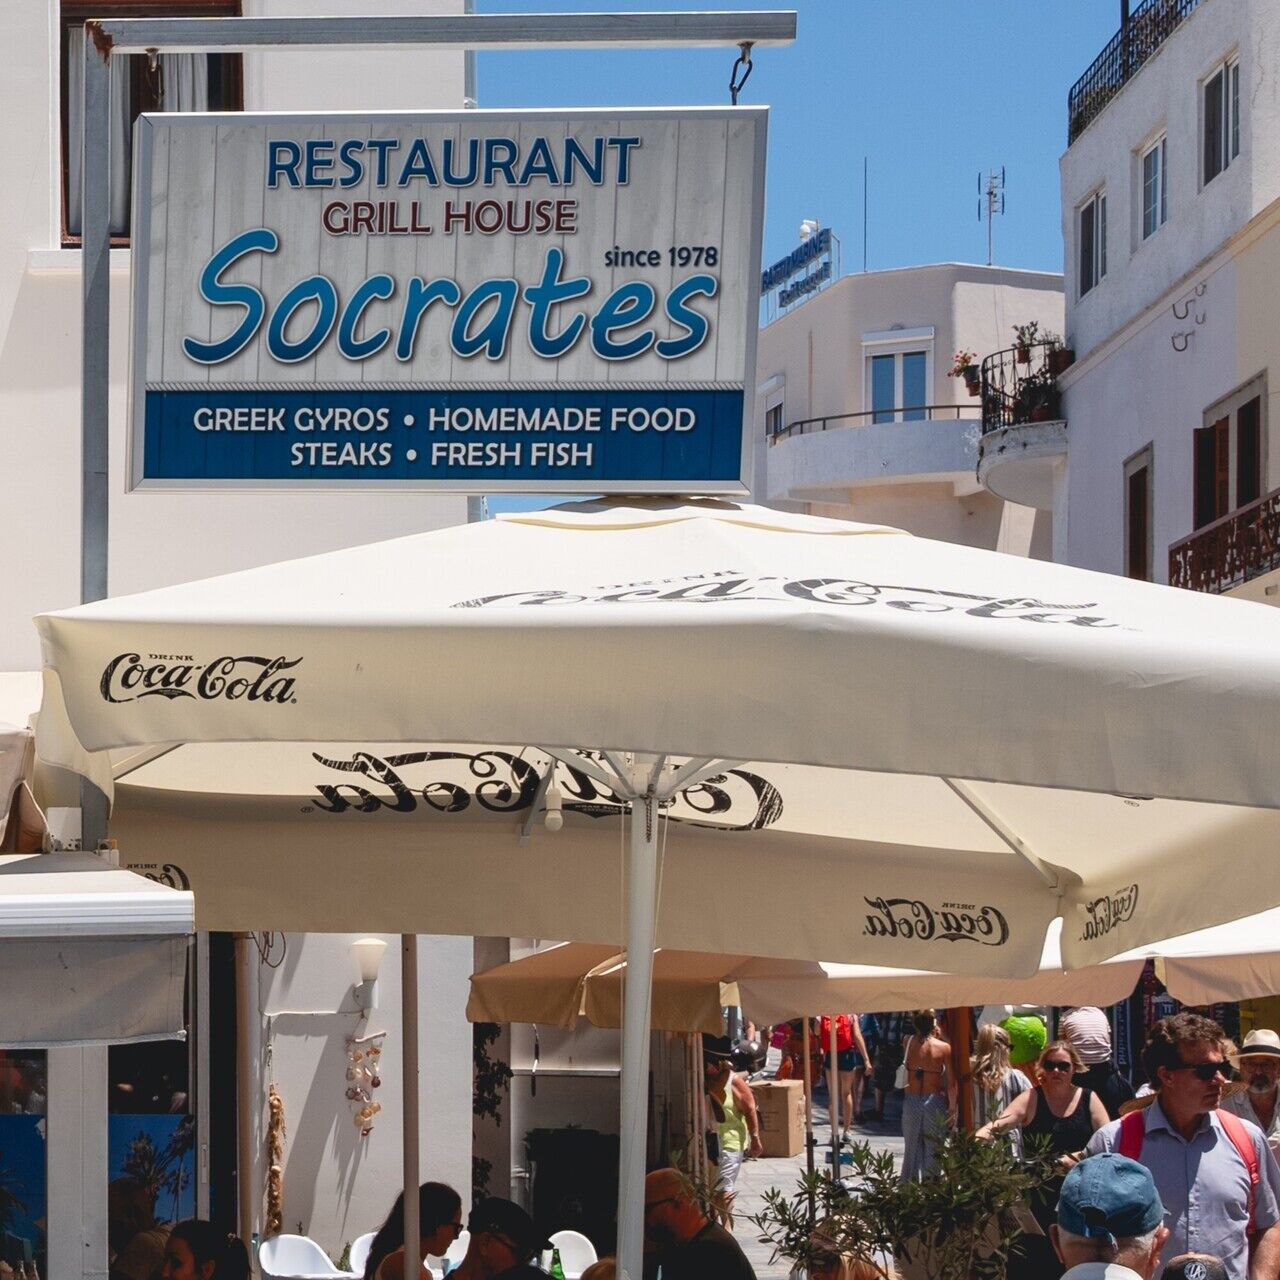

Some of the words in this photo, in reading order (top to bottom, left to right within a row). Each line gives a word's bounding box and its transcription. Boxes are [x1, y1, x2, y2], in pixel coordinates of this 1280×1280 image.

[266, 137, 640, 188] RESTAURANT
[322, 200, 432, 235] GRILL
[443, 199, 577, 234] HOUSE
[604, 246, 661, 268] since
[668, 246, 718, 267] 1978
[182, 227, 718, 364] Socrates
[193, 408, 286, 432] GREEK
[293, 408, 390, 432] GYROS
[428, 408, 601, 432] HOMEMADE
[611, 408, 696, 432] FOOD
[290, 442, 393, 466] STEAKS
[431, 442, 521, 466] FRESH
[530, 442, 593, 466] FISH
[149, 653, 194, 661] DRINK
[100, 652, 304, 704] Coca-Cola
